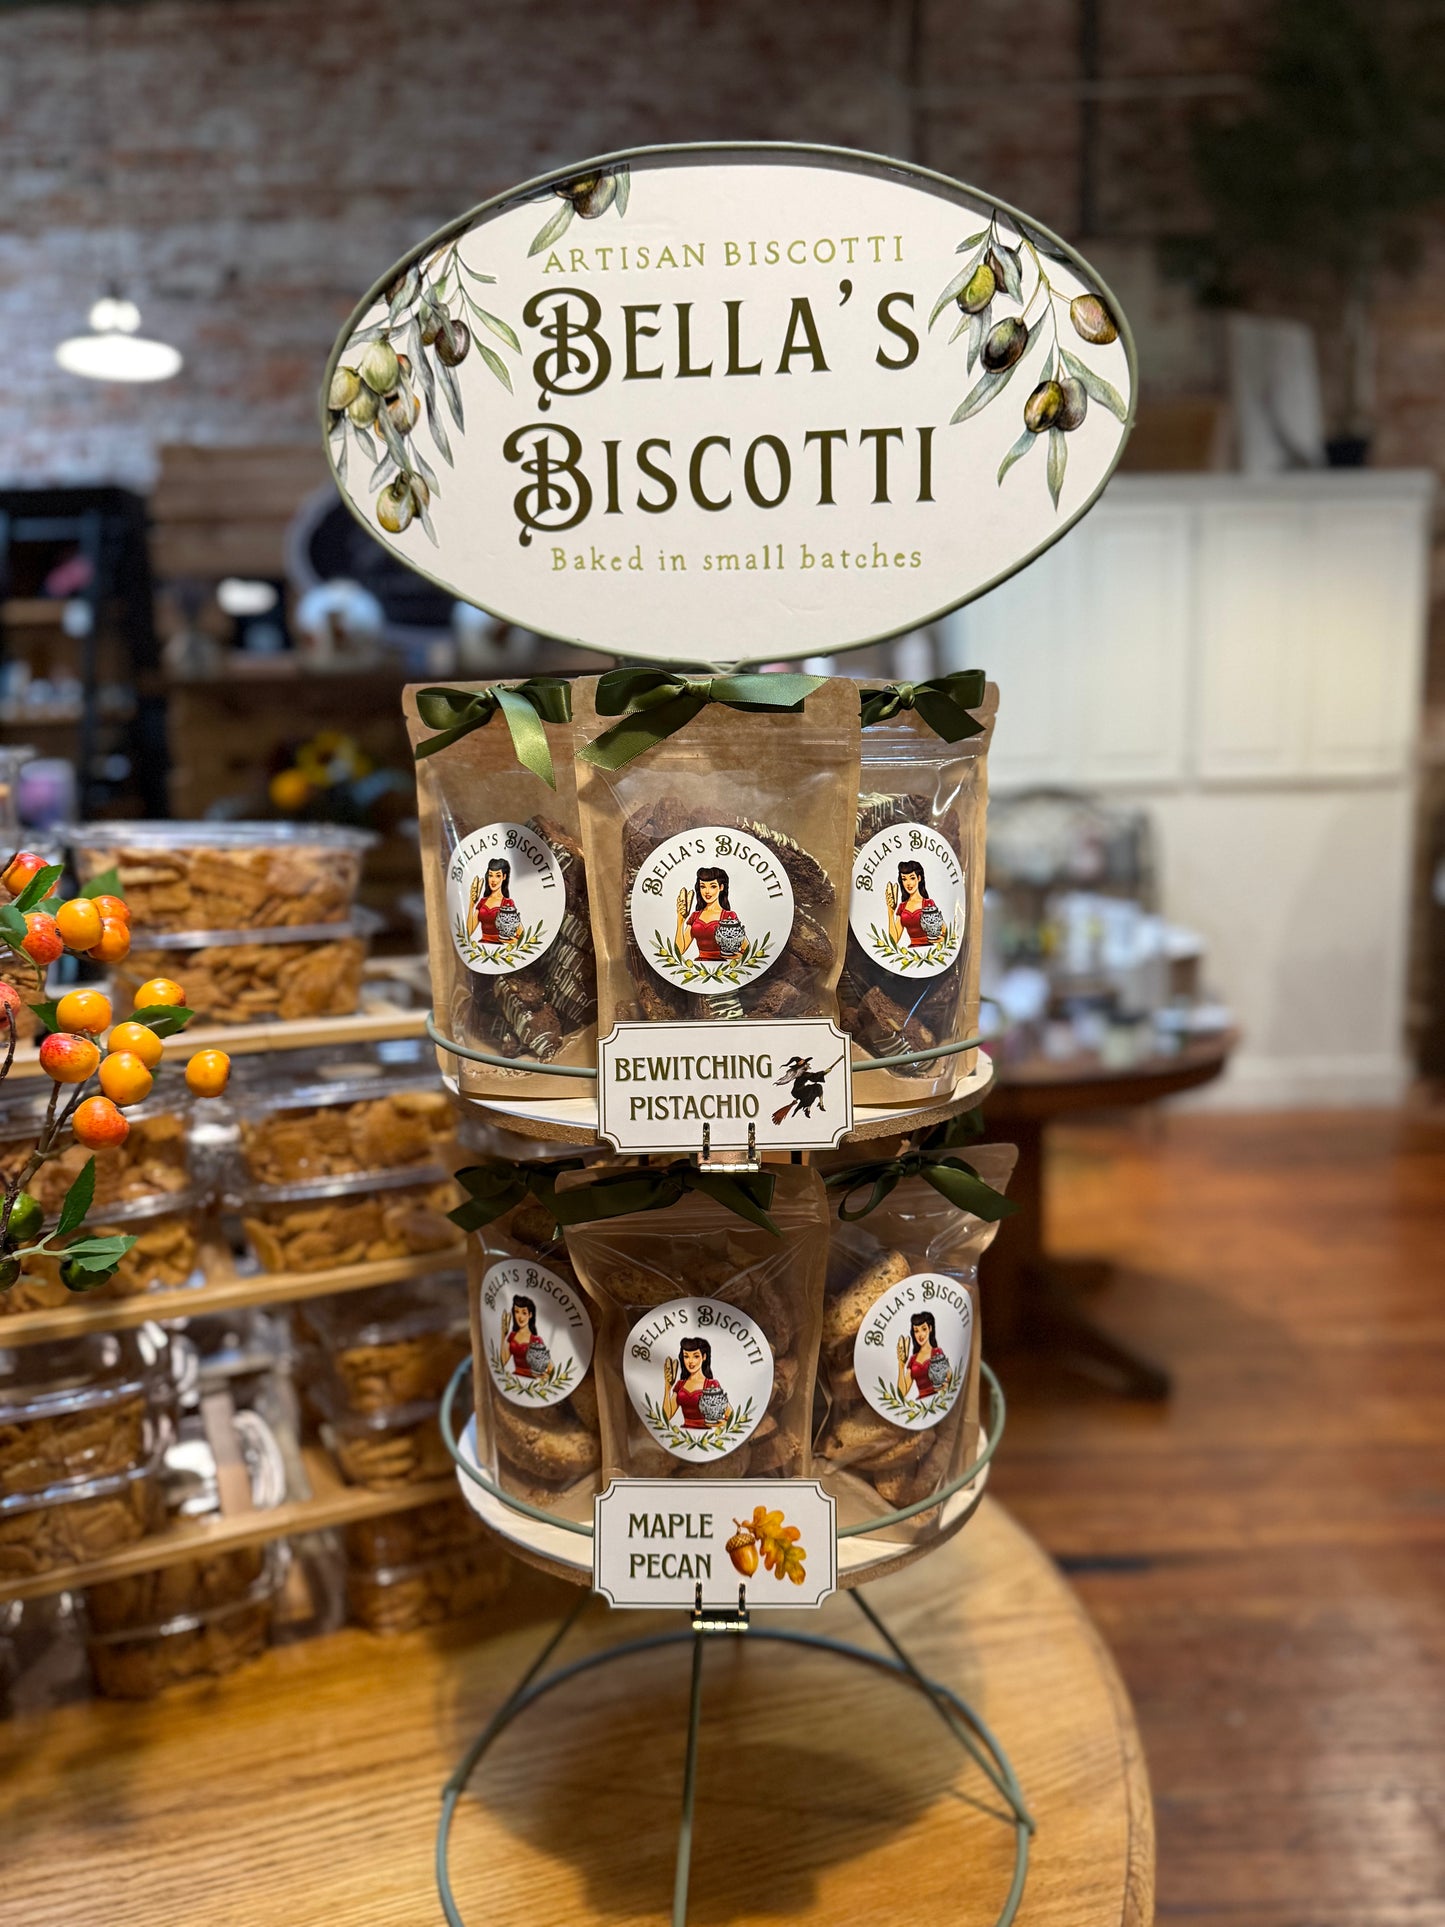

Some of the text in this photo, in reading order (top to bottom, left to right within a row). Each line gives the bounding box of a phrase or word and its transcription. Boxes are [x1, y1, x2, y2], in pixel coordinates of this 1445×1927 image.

[542, 236, 904, 274] ARTISAN BISCOTTI
[502, 422, 937, 548] BISCOTTI
[550, 541, 923, 572] Baked in small batches
[714, 833, 785, 900] BISCOTTI
[614, 1053, 773, 1083] BEWITCHING
[629, 1092, 760, 1122] PISTACHIO
[697, 1305, 763, 1366] BISCOTTI
[627, 1512, 714, 1539] MAPLE
[629, 1552, 713, 1580] PECAN
